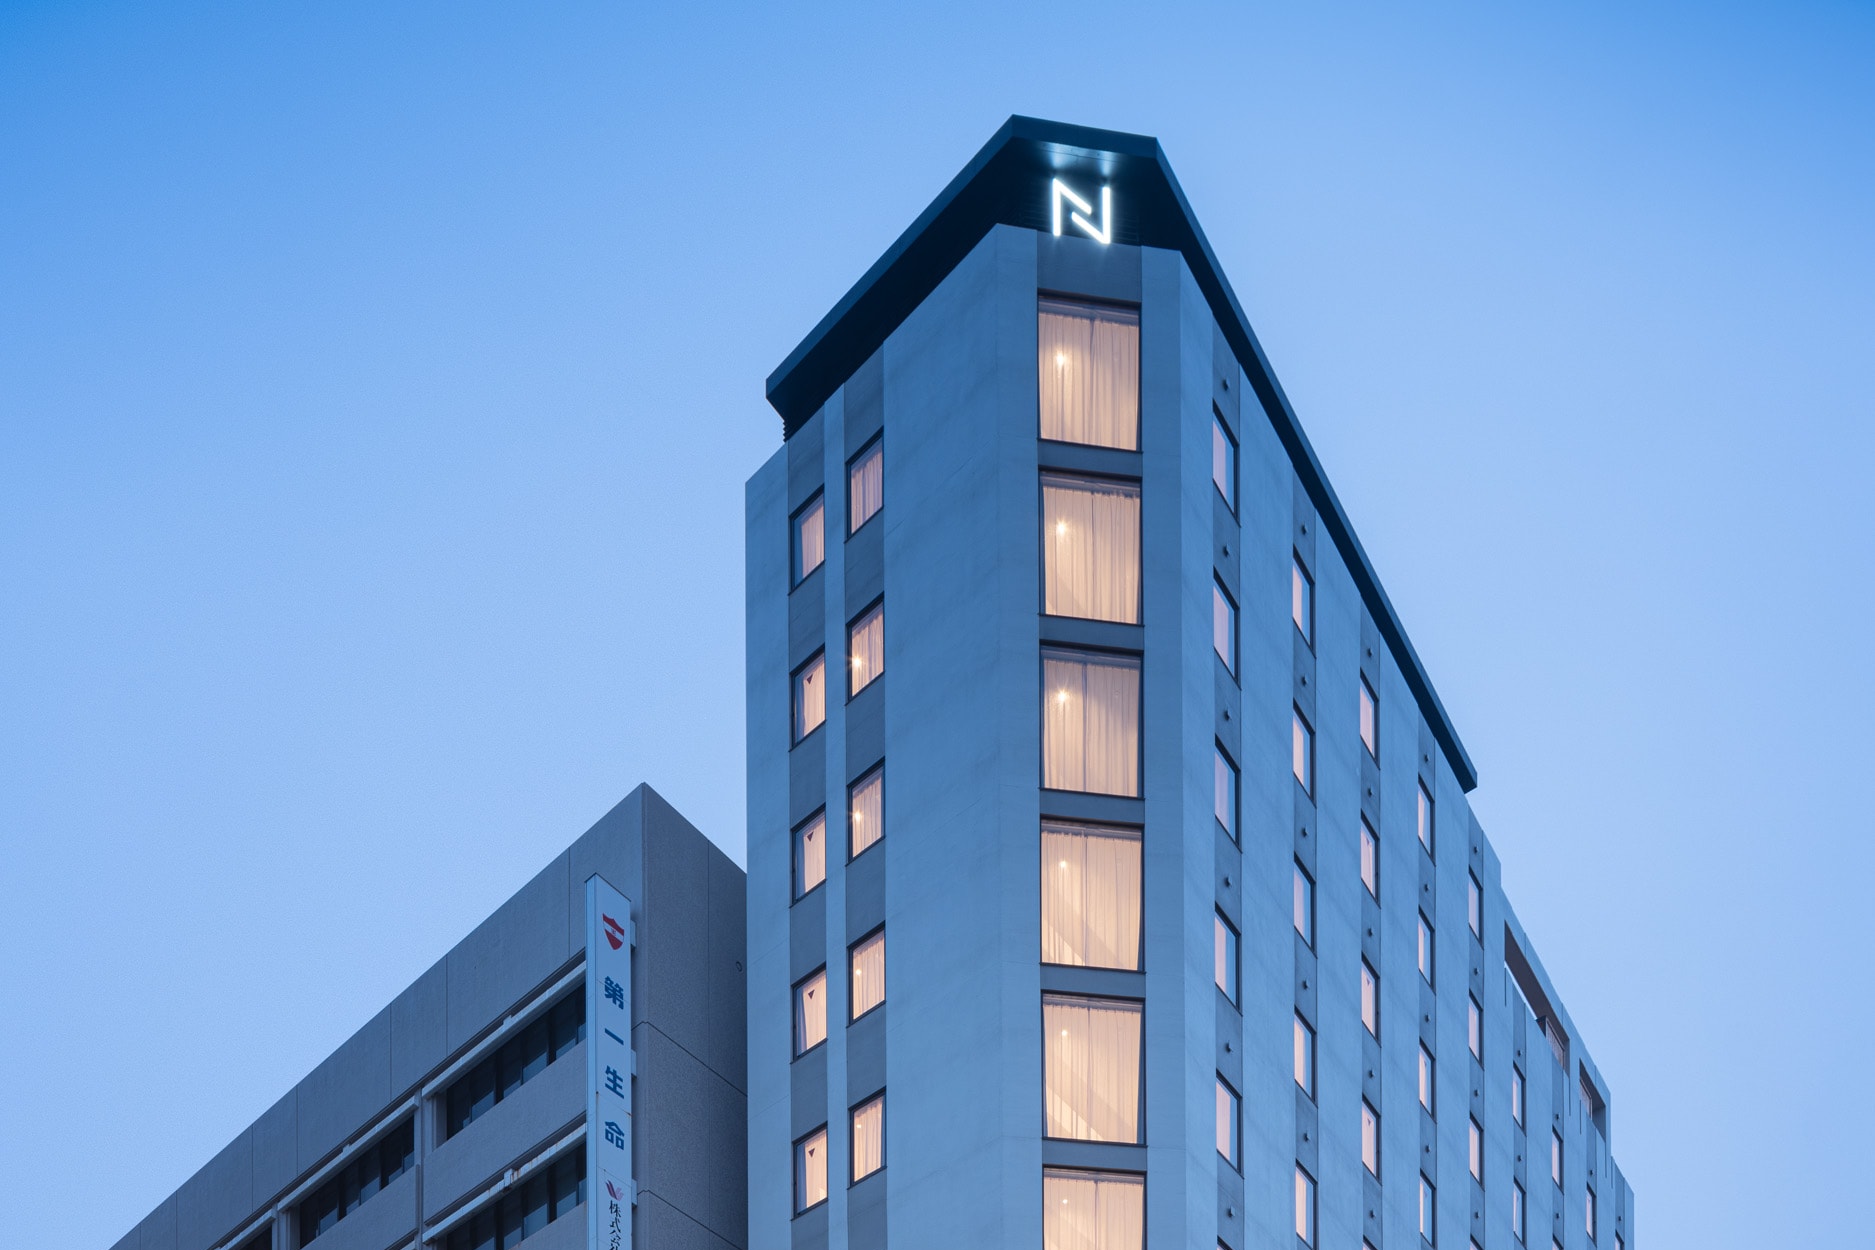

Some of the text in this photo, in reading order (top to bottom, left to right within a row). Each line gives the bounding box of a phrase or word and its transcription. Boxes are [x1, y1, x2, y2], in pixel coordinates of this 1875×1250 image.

[1052, 177, 1111, 244] N
[604, 975, 625, 1151] 第一生命
